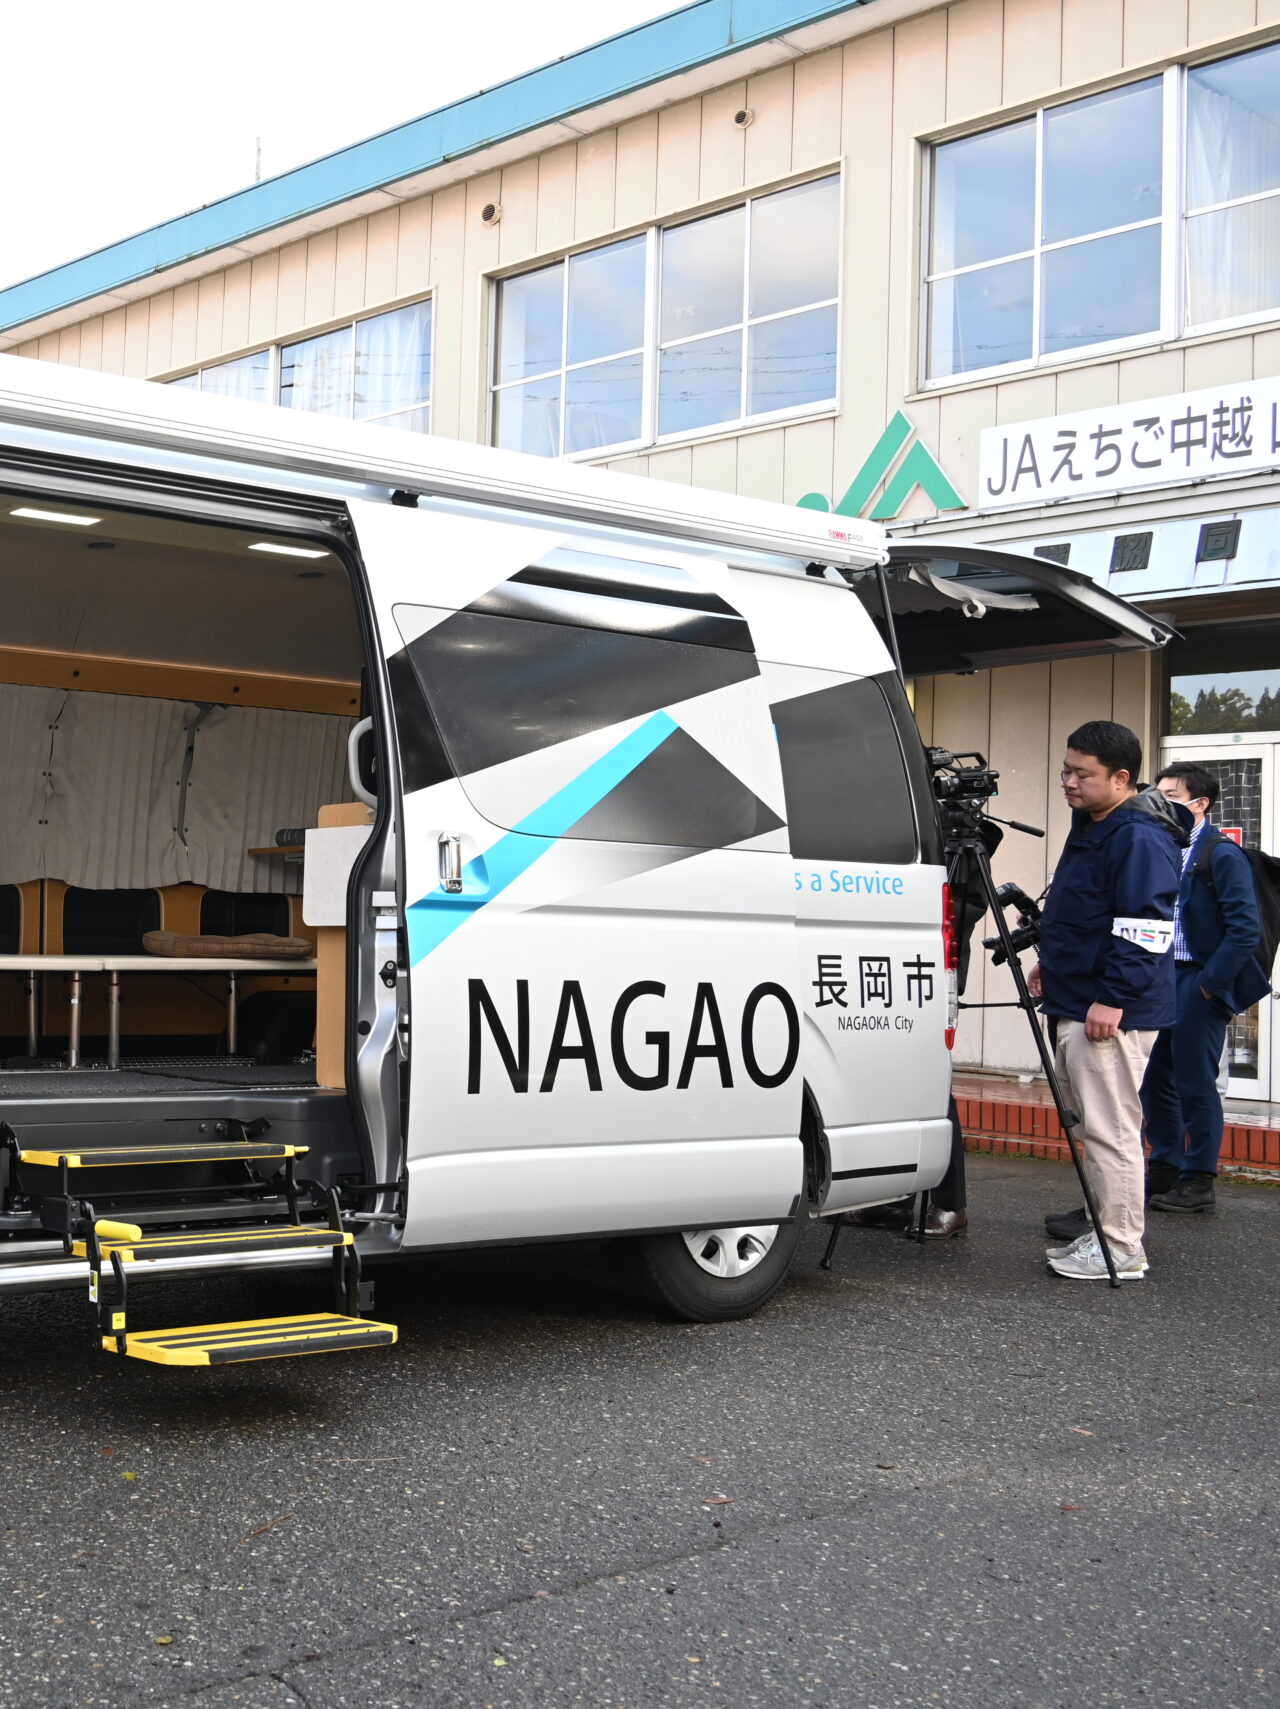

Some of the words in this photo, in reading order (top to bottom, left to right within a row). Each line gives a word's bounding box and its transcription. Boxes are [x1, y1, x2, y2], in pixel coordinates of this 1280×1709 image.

[986, 395, 1253, 496] JAえちご中越
[810, 873, 823, 892] a
[829, 869, 904, 895] Service
[812, 954, 936, 1009] 長岡市
[467, 978, 801, 1095] NAGAO
[838, 1015, 890, 1031] NAGAOKA
[894, 1015, 914, 1033] City
